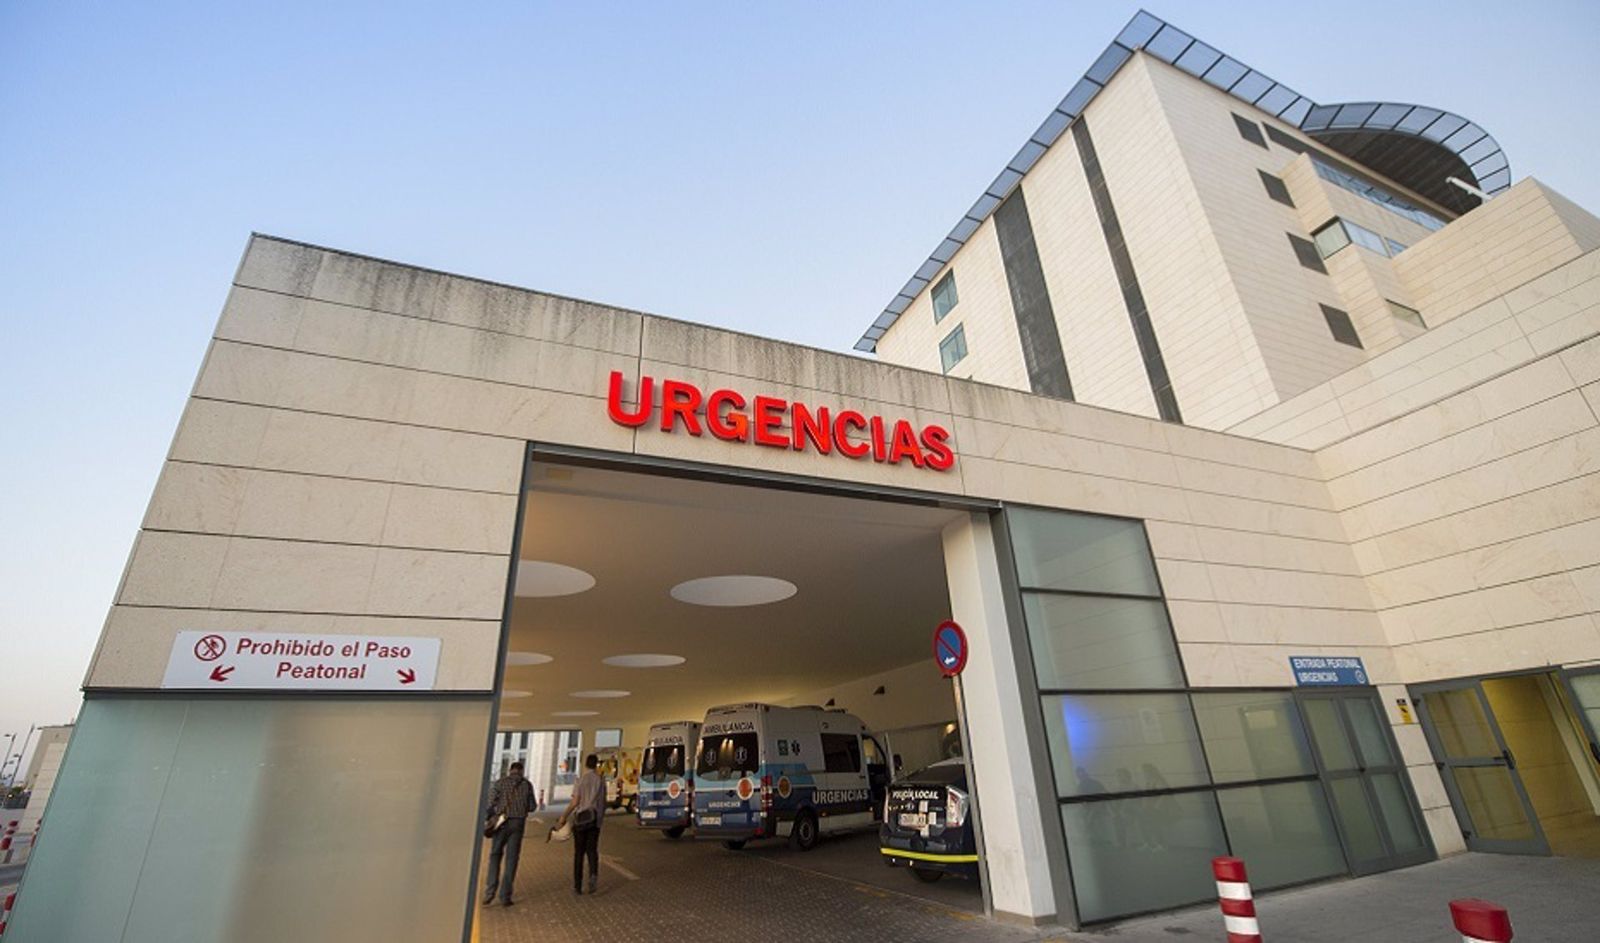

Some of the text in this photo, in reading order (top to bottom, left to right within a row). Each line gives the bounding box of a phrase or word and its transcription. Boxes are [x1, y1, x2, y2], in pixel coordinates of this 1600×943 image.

[607, 371, 955, 472] URGENCIAS
[236, 638, 412, 659] Prohibido el Paso
[276, 661, 367, 680] Peatonal
[1293, 658, 1361, 669] ENTRADA PEATONAL
[1298, 672, 1339, 683] URGENCIAS
[812, 789, 869, 805] URGENCIAS
[914, 790, 939, 800] LOCAL
